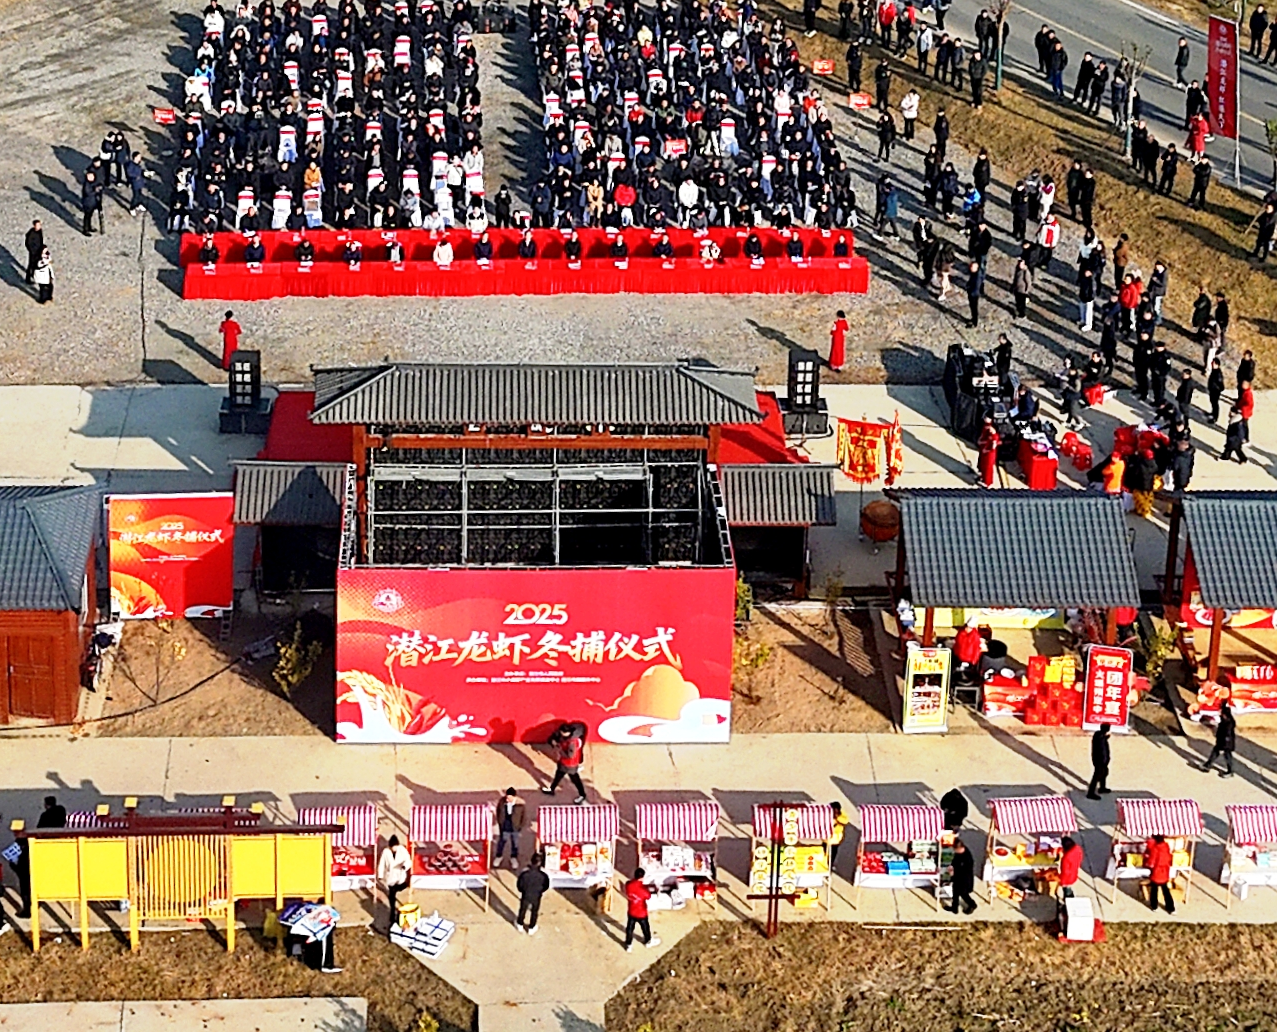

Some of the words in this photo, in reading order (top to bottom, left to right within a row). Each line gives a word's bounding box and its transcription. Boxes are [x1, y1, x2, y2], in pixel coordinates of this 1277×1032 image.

[503, 603, 568, 625] 2025
[384, 626, 683, 670] 潜江龙虾冬捕仪式
